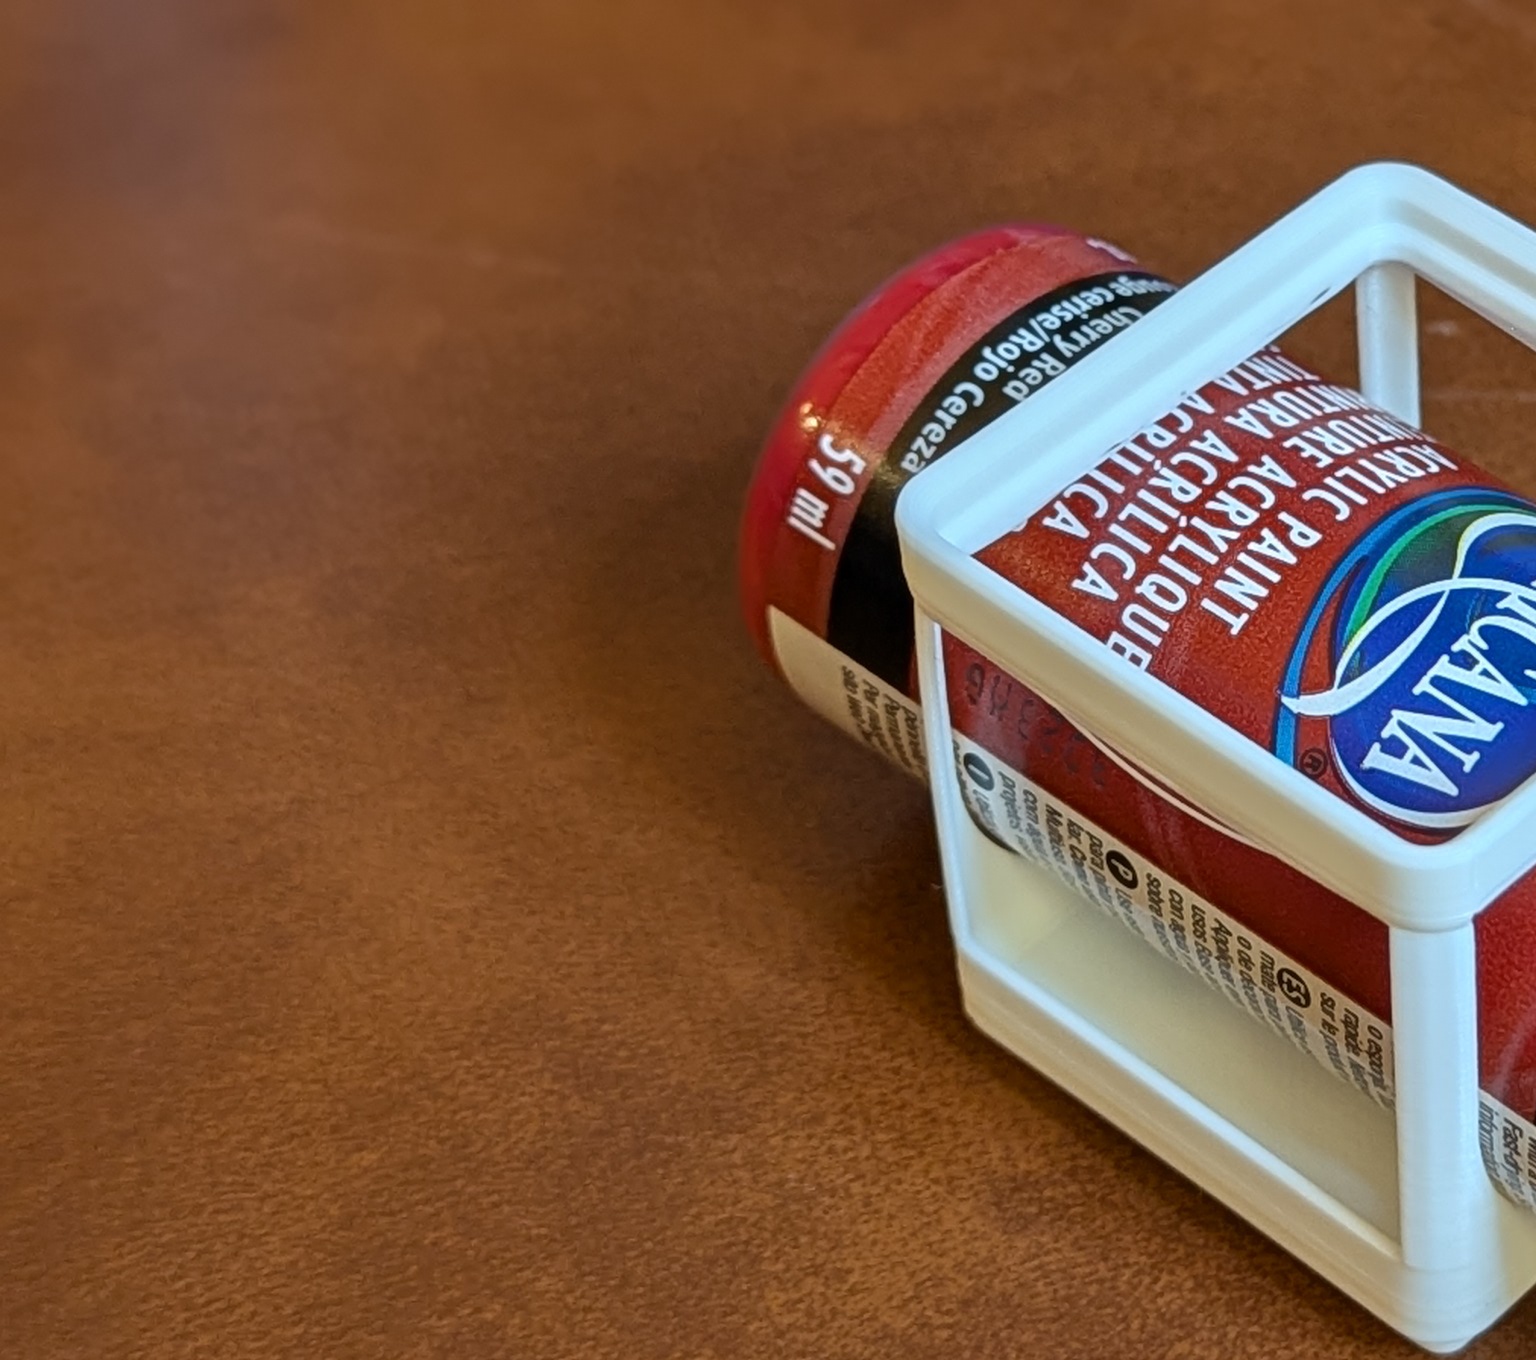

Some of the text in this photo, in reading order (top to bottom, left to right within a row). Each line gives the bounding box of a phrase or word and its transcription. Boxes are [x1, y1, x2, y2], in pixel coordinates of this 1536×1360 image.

[1002, 305, 1144, 402] Cherry Red
[786, 433, 867, 551] 59 ml
[901, 381, 985, 474] Cereza
[1071, 428, 1240, 602] ACRÍLICA
[1104, 453, 1298, 674] ACRYLIQUE
[1200, 443, 1459, 636] ACRYLIC PAINT
